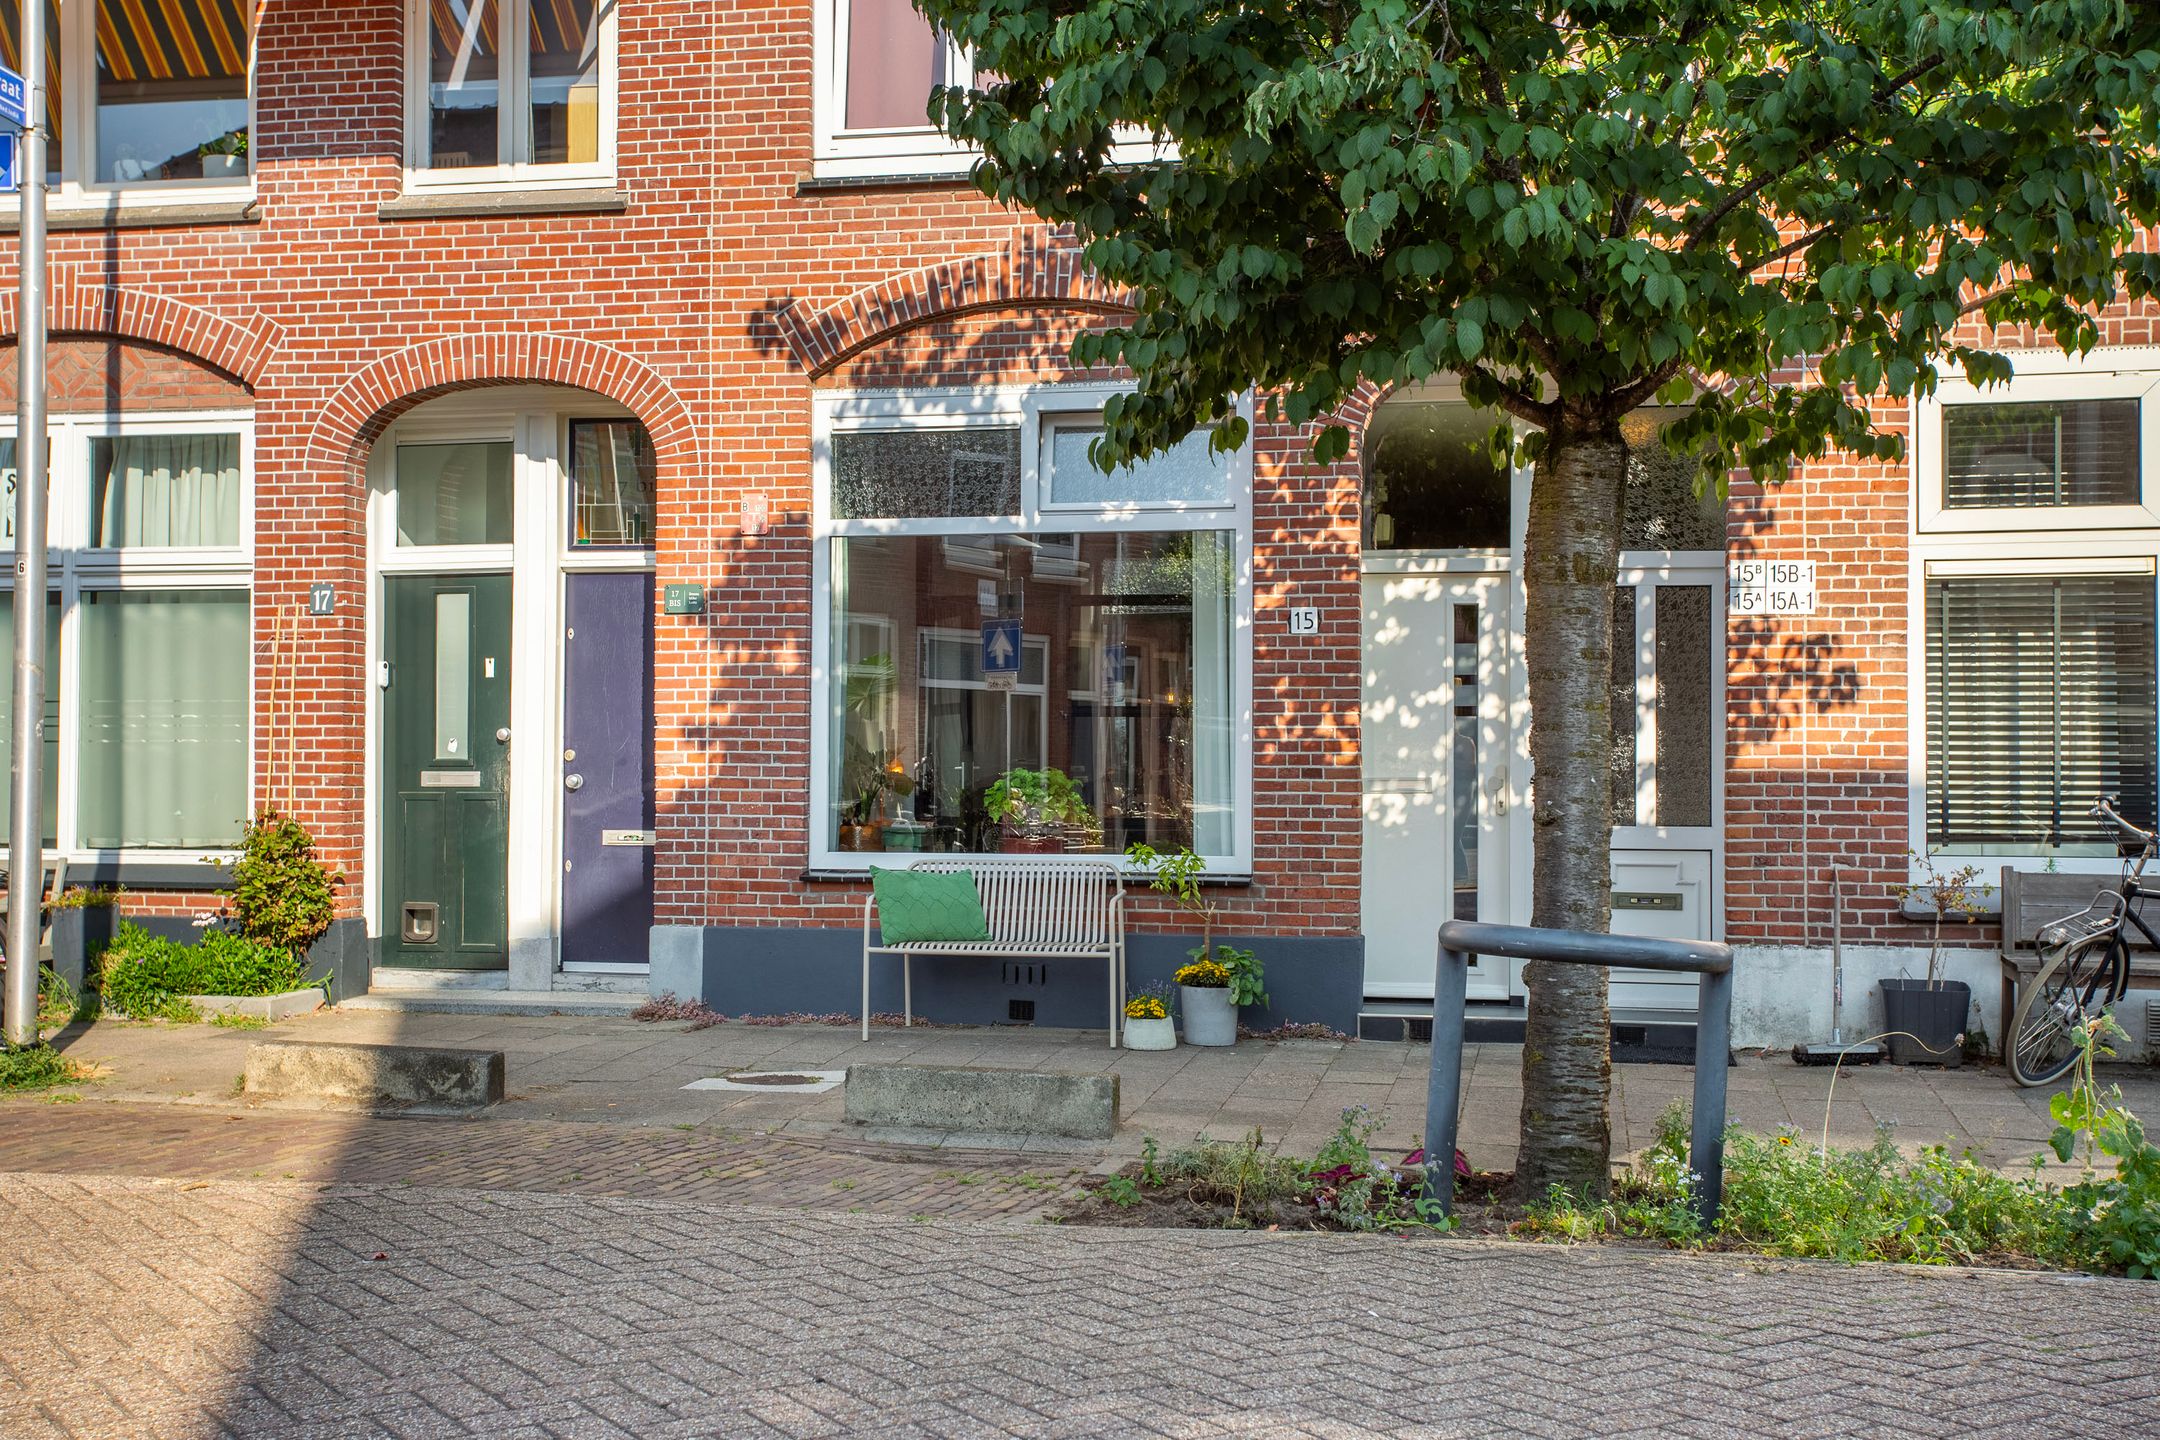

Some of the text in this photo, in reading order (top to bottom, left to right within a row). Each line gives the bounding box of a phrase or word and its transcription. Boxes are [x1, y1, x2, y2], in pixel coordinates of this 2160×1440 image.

[0, 77, 21, 100] aat
[742, 502, 749, 512] B
[18, 562, 25, 573] 6
[1734, 564, 1762, 583] 15B
[1770, 564, 1813, 583] 15B-1
[313, 590, 331, 611] 17
[669, 599, 681, 607] BIS
[671, 590, 680, 598] 17
[1734, 592, 1762, 610] 15A
[1770, 591, 1813, 610] 15A-1
[1294, 611, 1314, 630] 15
